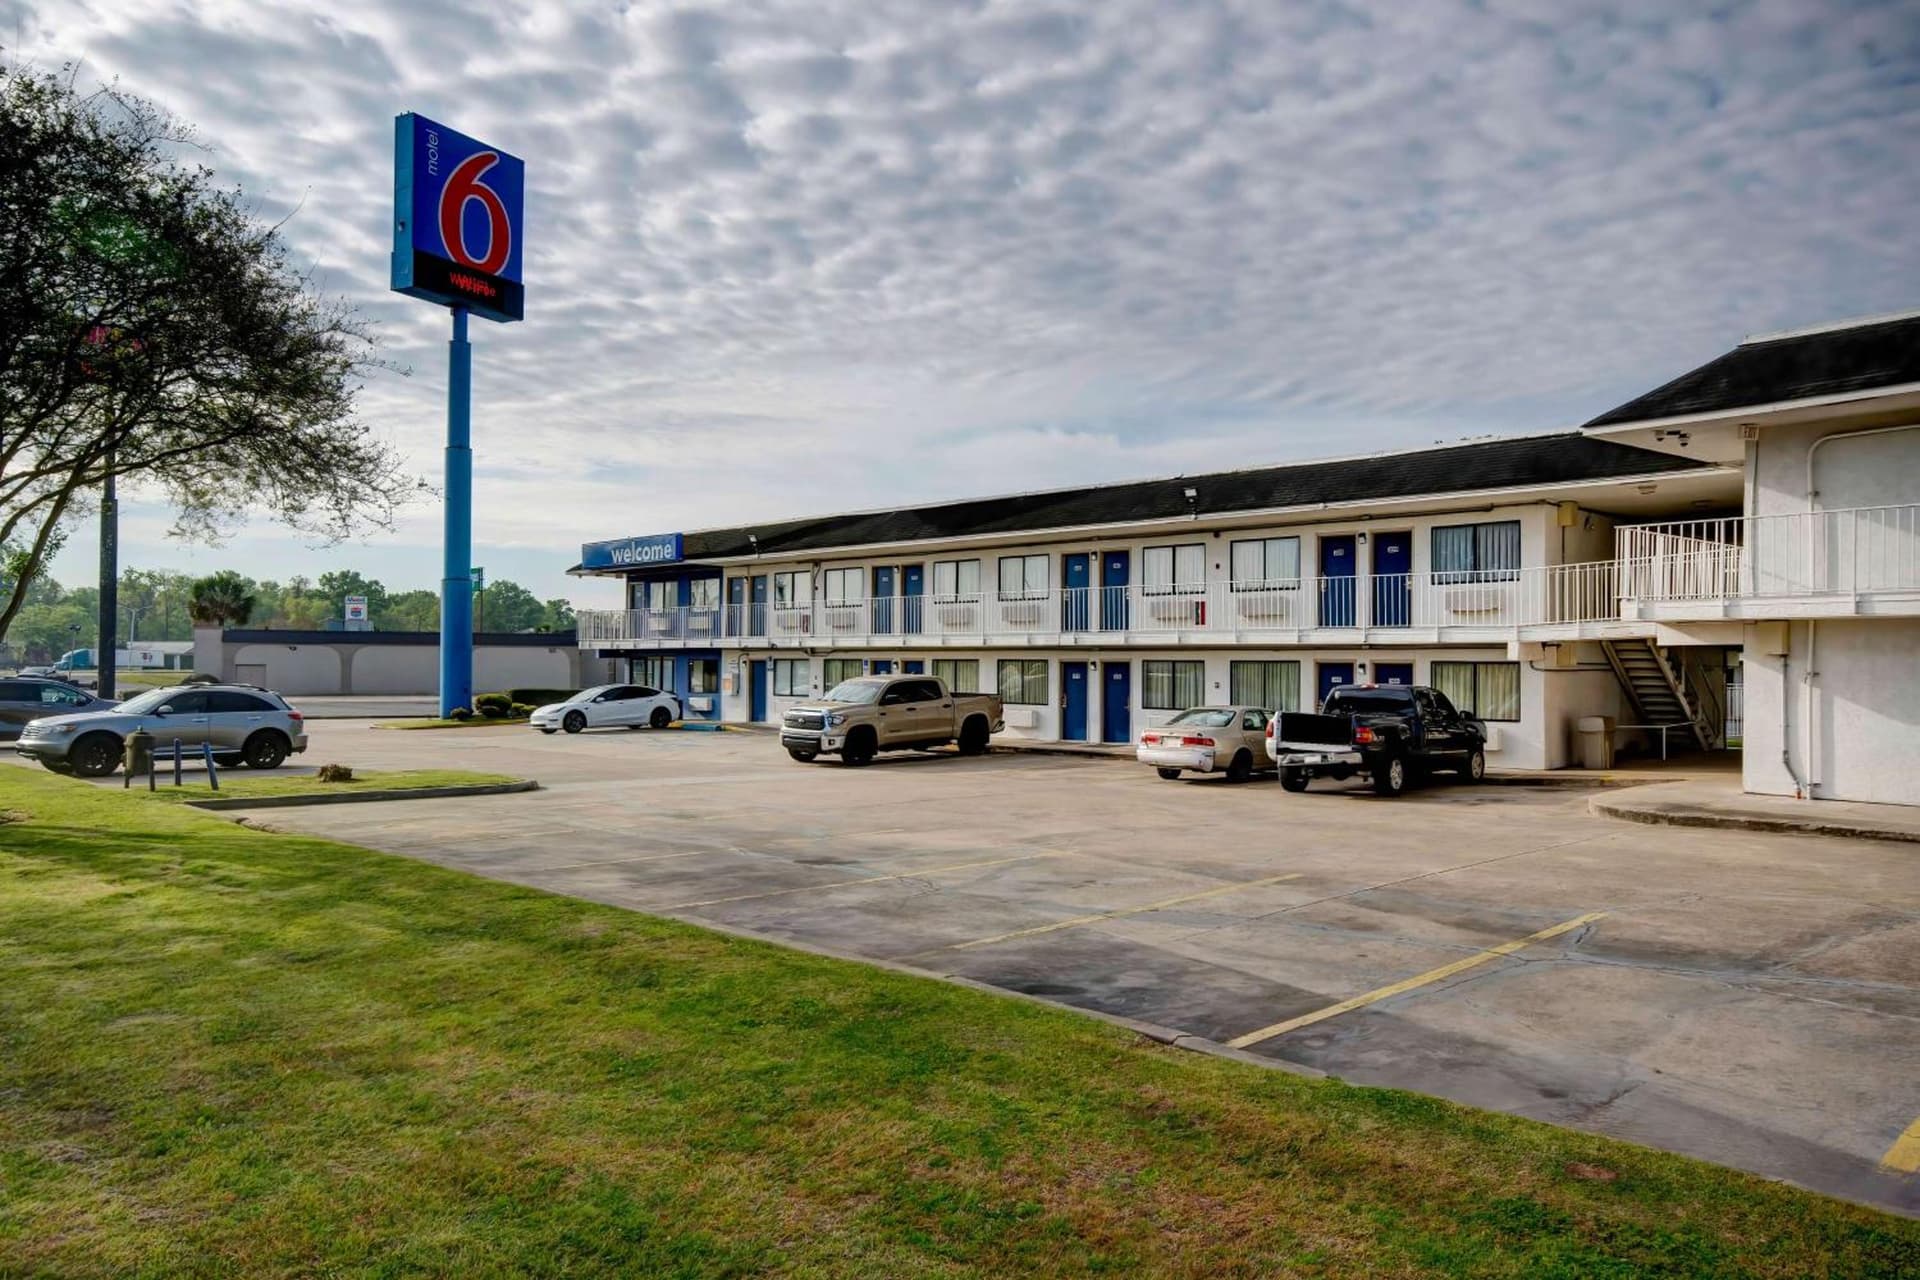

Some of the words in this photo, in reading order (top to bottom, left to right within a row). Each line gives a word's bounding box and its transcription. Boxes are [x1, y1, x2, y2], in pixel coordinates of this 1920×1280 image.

[425, 128, 439, 176] motel
[438, 150, 511, 276] 6
[611, 541, 672, 563] welcome
